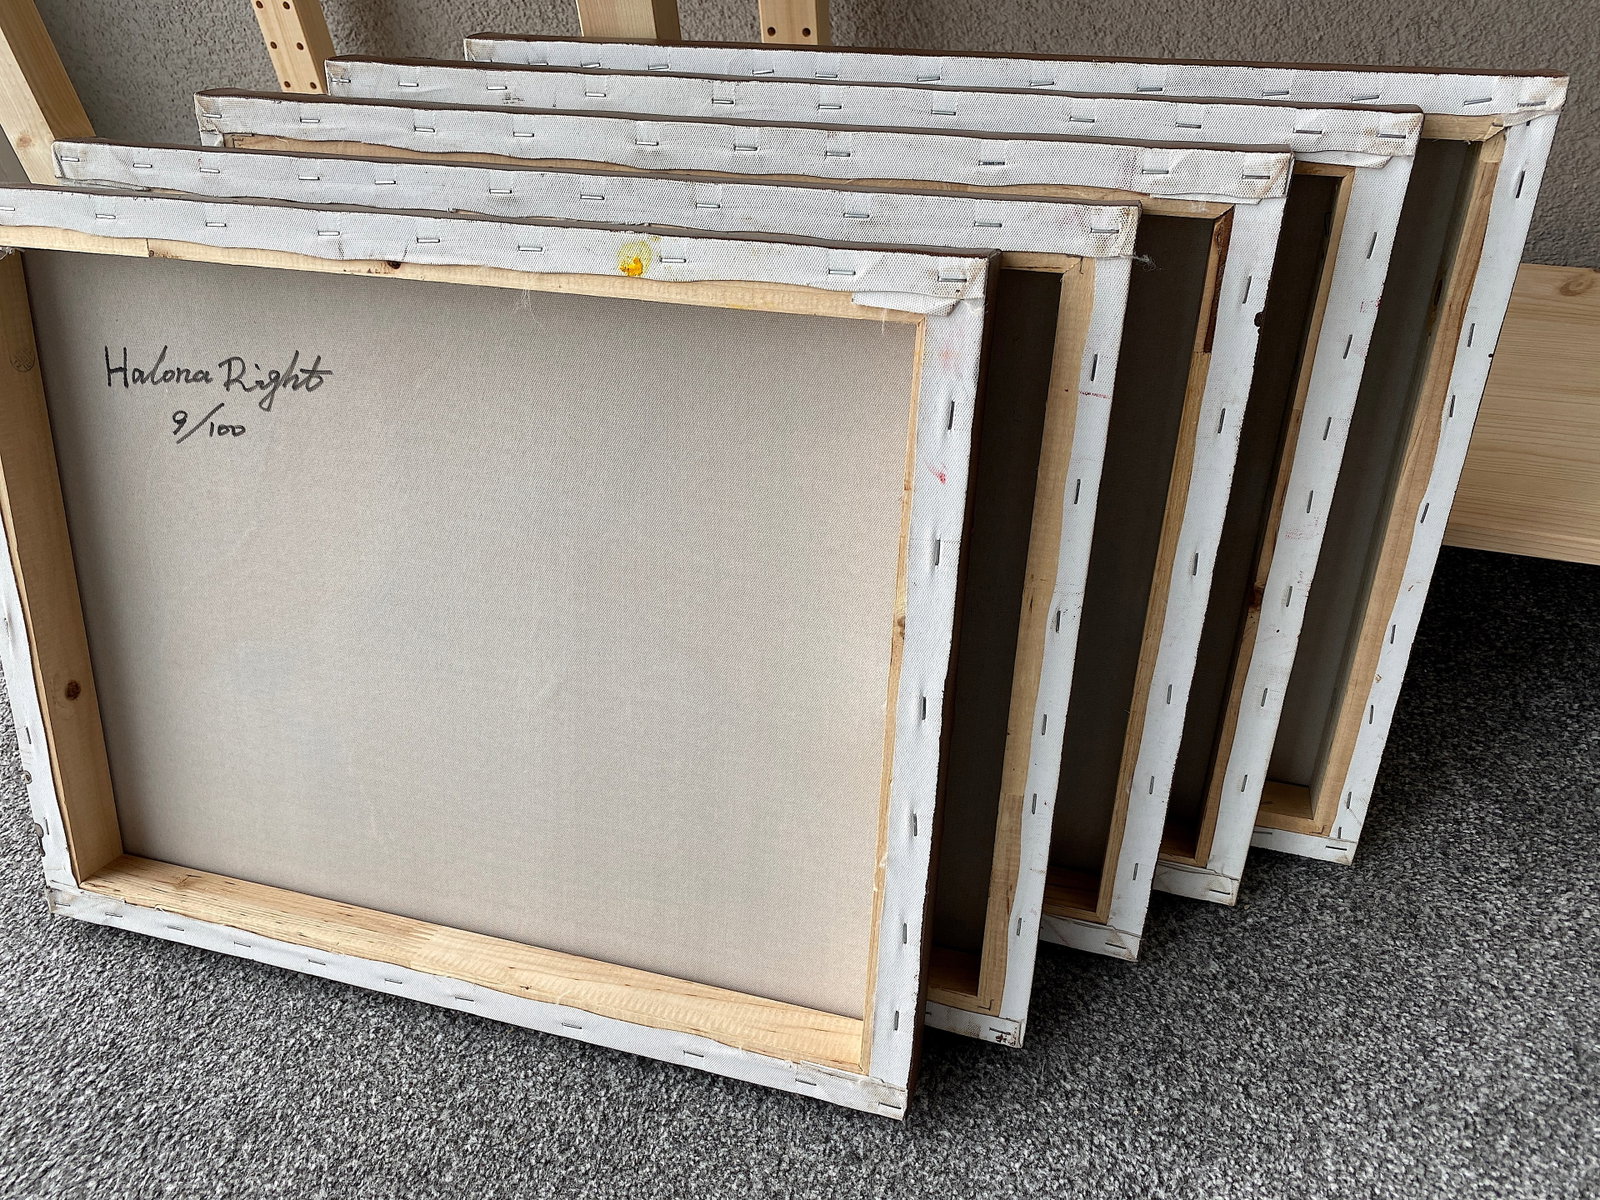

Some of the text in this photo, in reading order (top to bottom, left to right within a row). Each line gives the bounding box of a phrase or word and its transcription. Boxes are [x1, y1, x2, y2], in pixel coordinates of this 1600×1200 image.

[104, 344, 334, 413] Halona Right
[171, 402, 247, 445] 9/100
